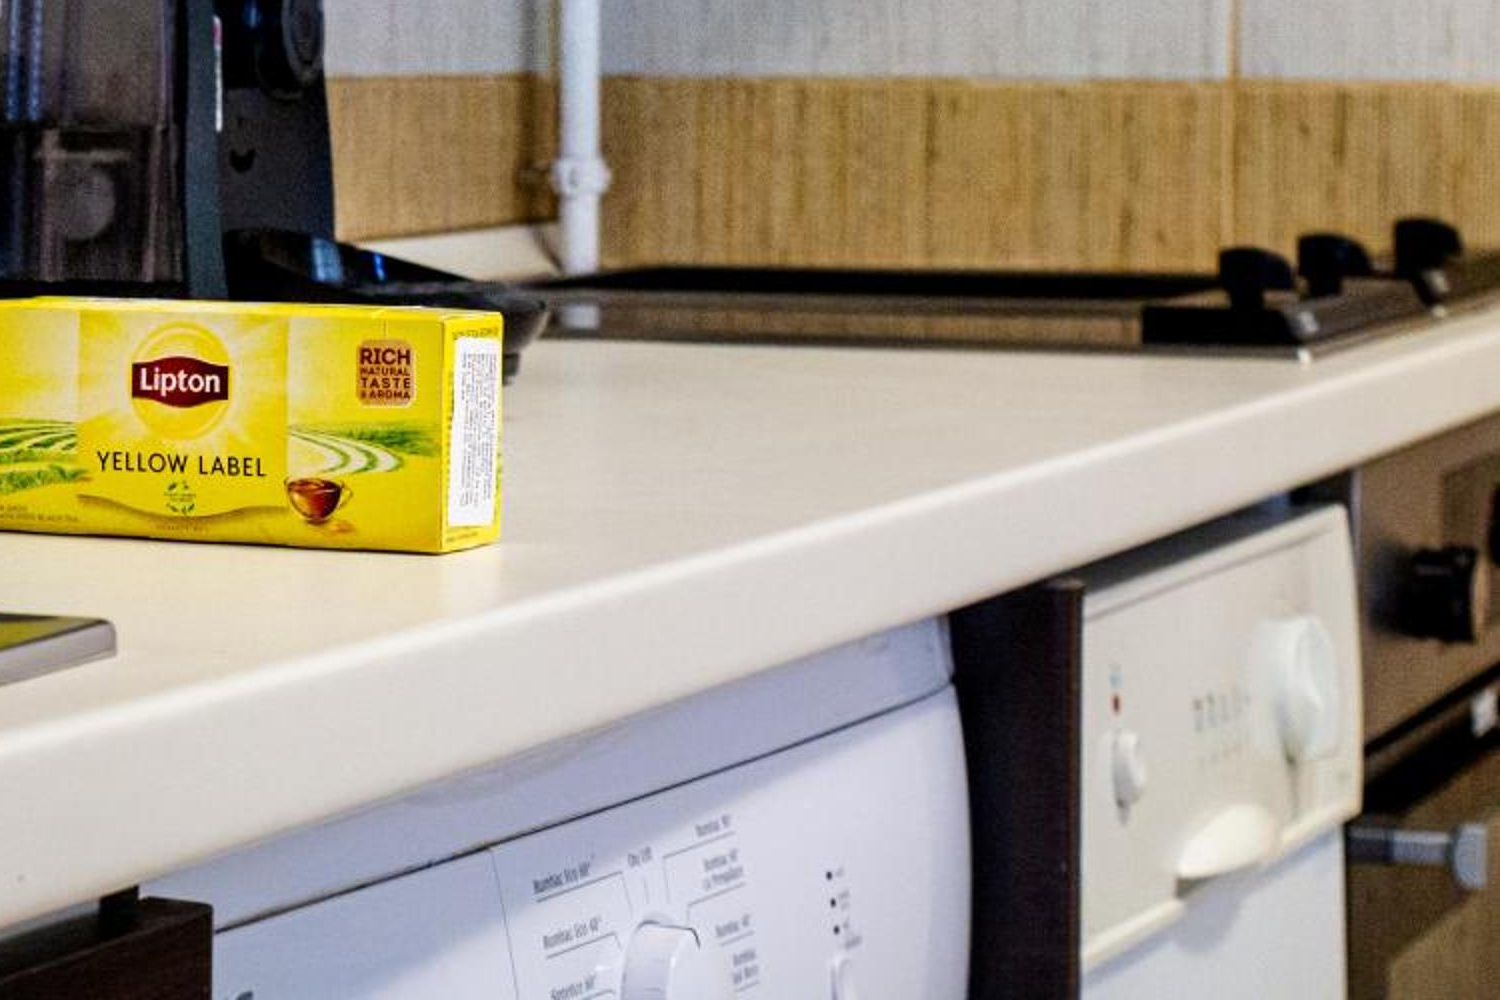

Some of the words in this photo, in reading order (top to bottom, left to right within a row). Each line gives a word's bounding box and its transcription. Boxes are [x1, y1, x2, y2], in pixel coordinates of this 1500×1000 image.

[360, 347, 411, 365] RICH
[140, 367, 221, 397] Lipton
[361, 377, 411, 389] TASTE
[370, 389, 411, 400] AROMA
[97, 451, 188, 473] YELLOW
[199, 455, 267, 477] LABEL
